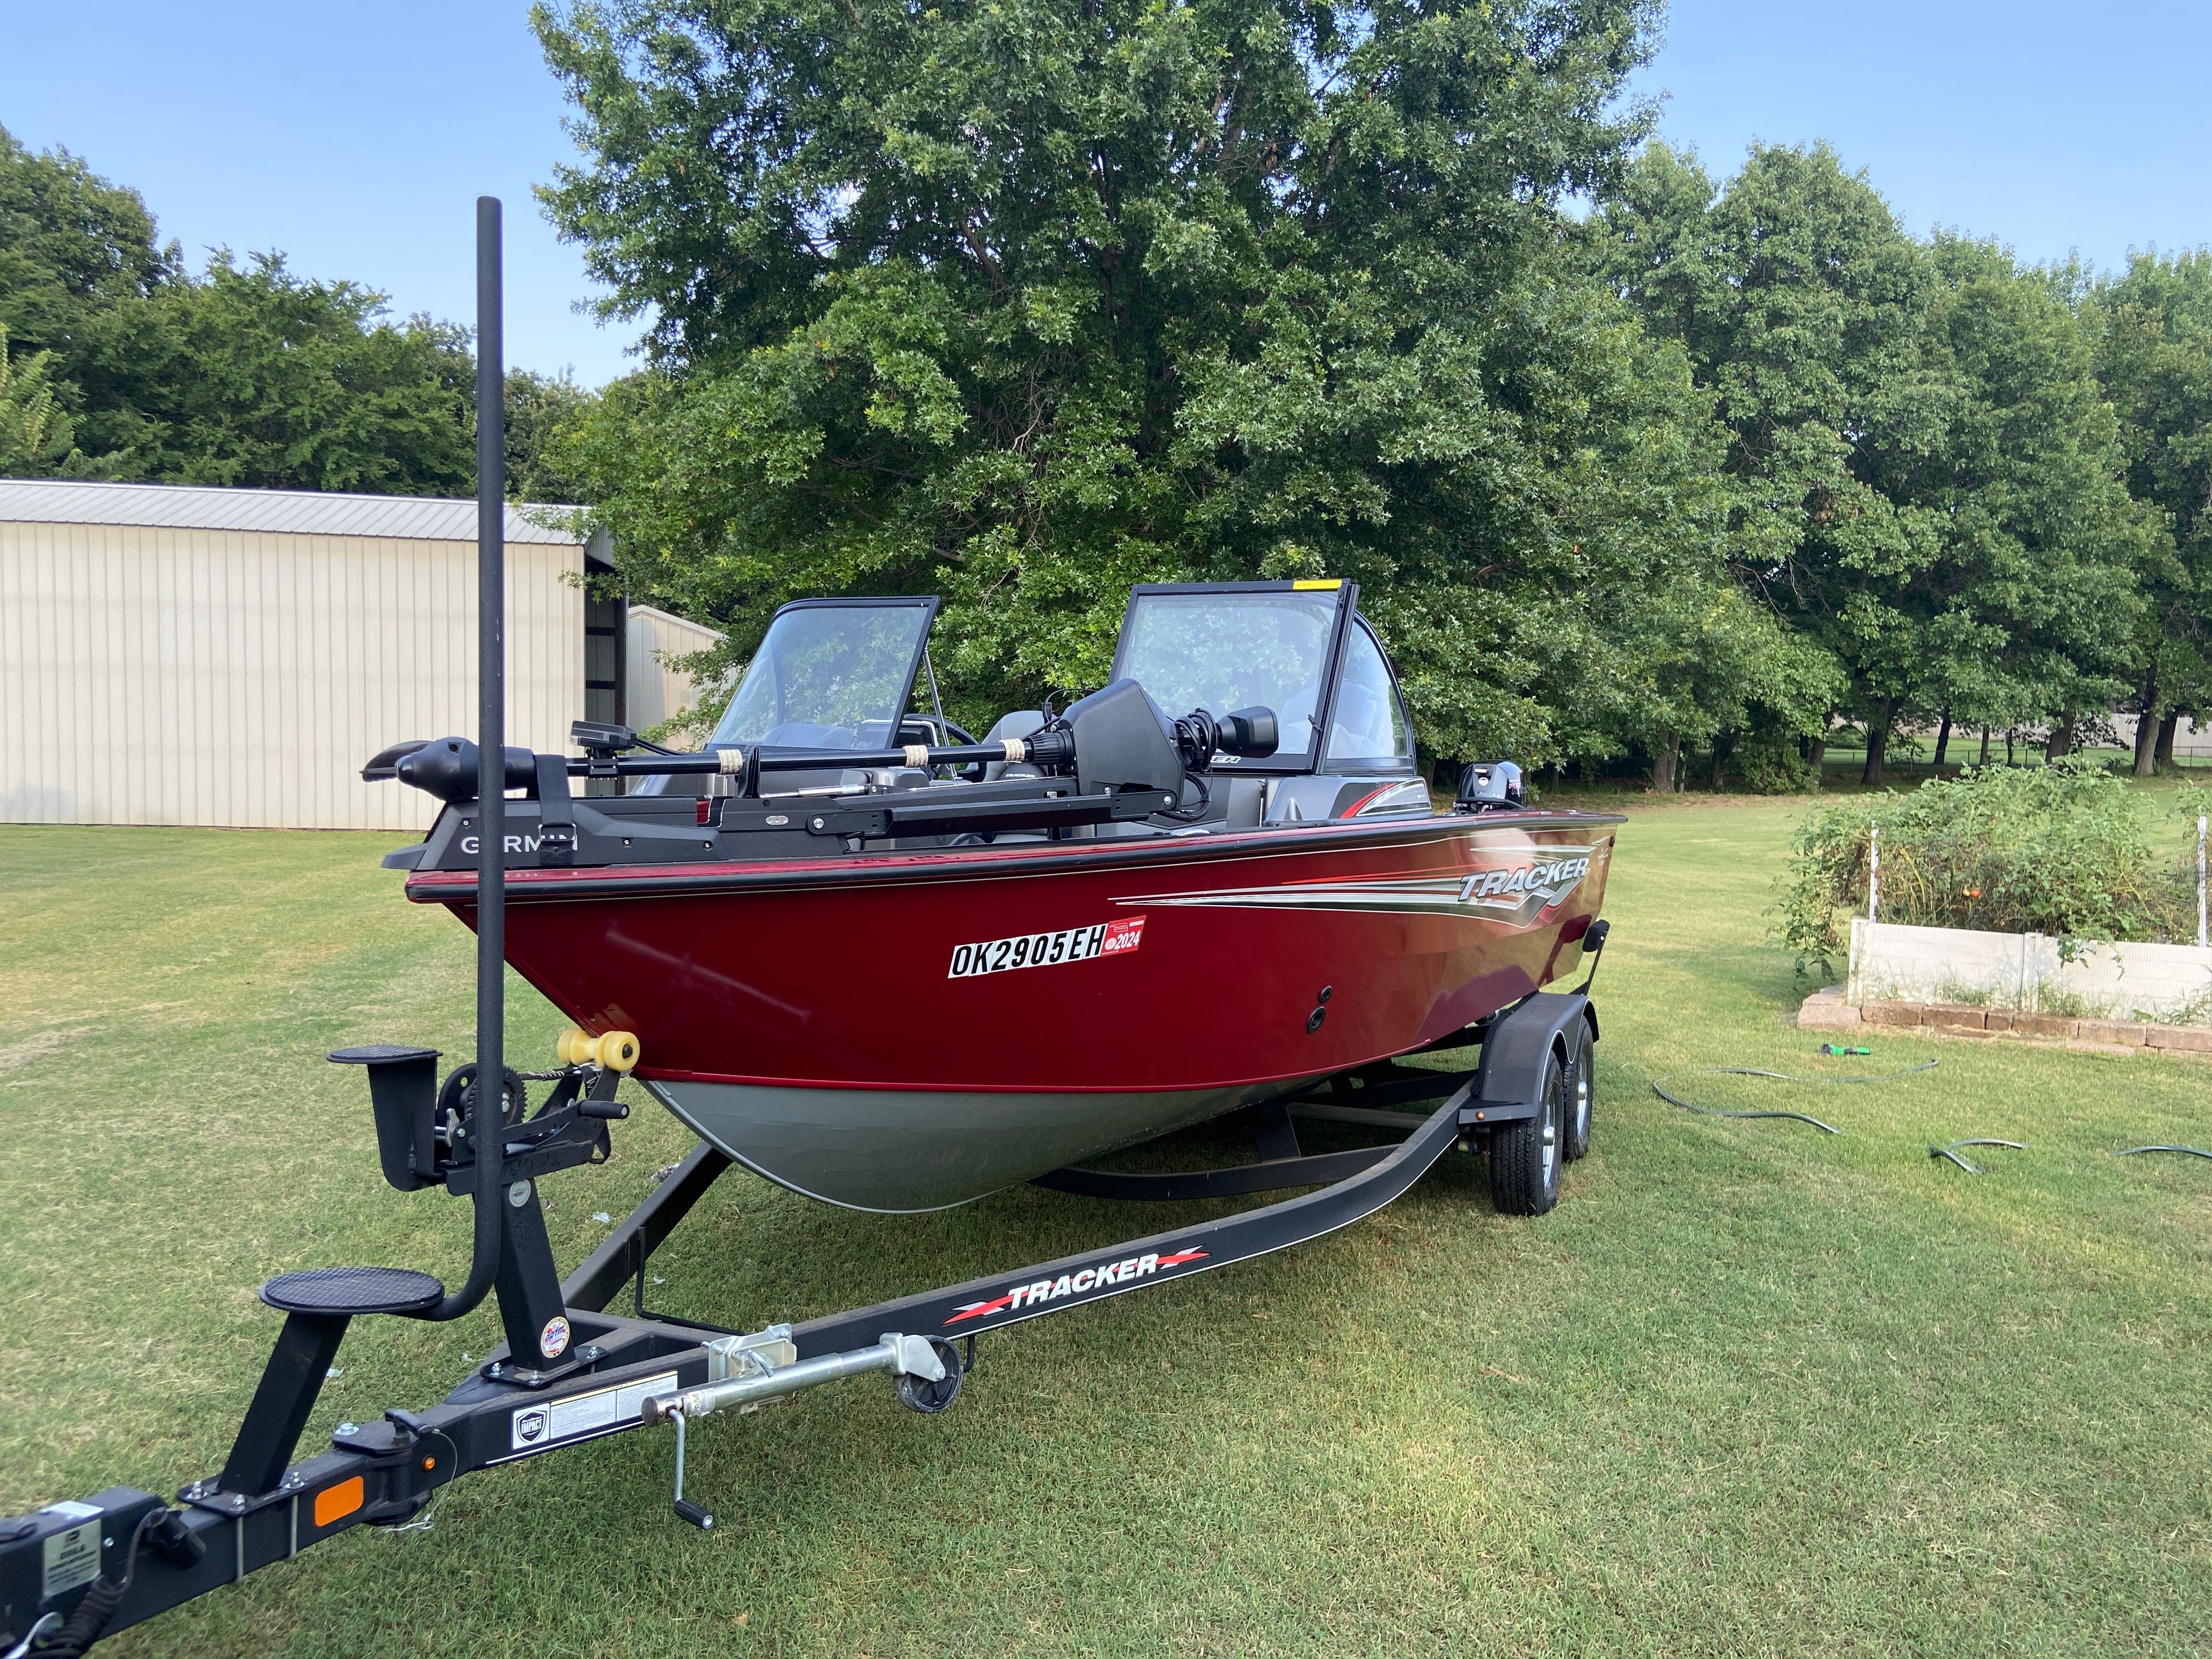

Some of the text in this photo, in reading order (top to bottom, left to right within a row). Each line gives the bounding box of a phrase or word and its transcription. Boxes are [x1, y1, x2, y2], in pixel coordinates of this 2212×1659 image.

[461, 835, 578, 854] GRM
[1458, 857, 1589, 902] TRACKER
[952, 924, 1107, 975] OK2905EH
[1114, 930, 1141, 950] 2024
[1008, 1253, 1159, 1310] TRACKER
[521, 1418, 543, 1434] IMPACT
